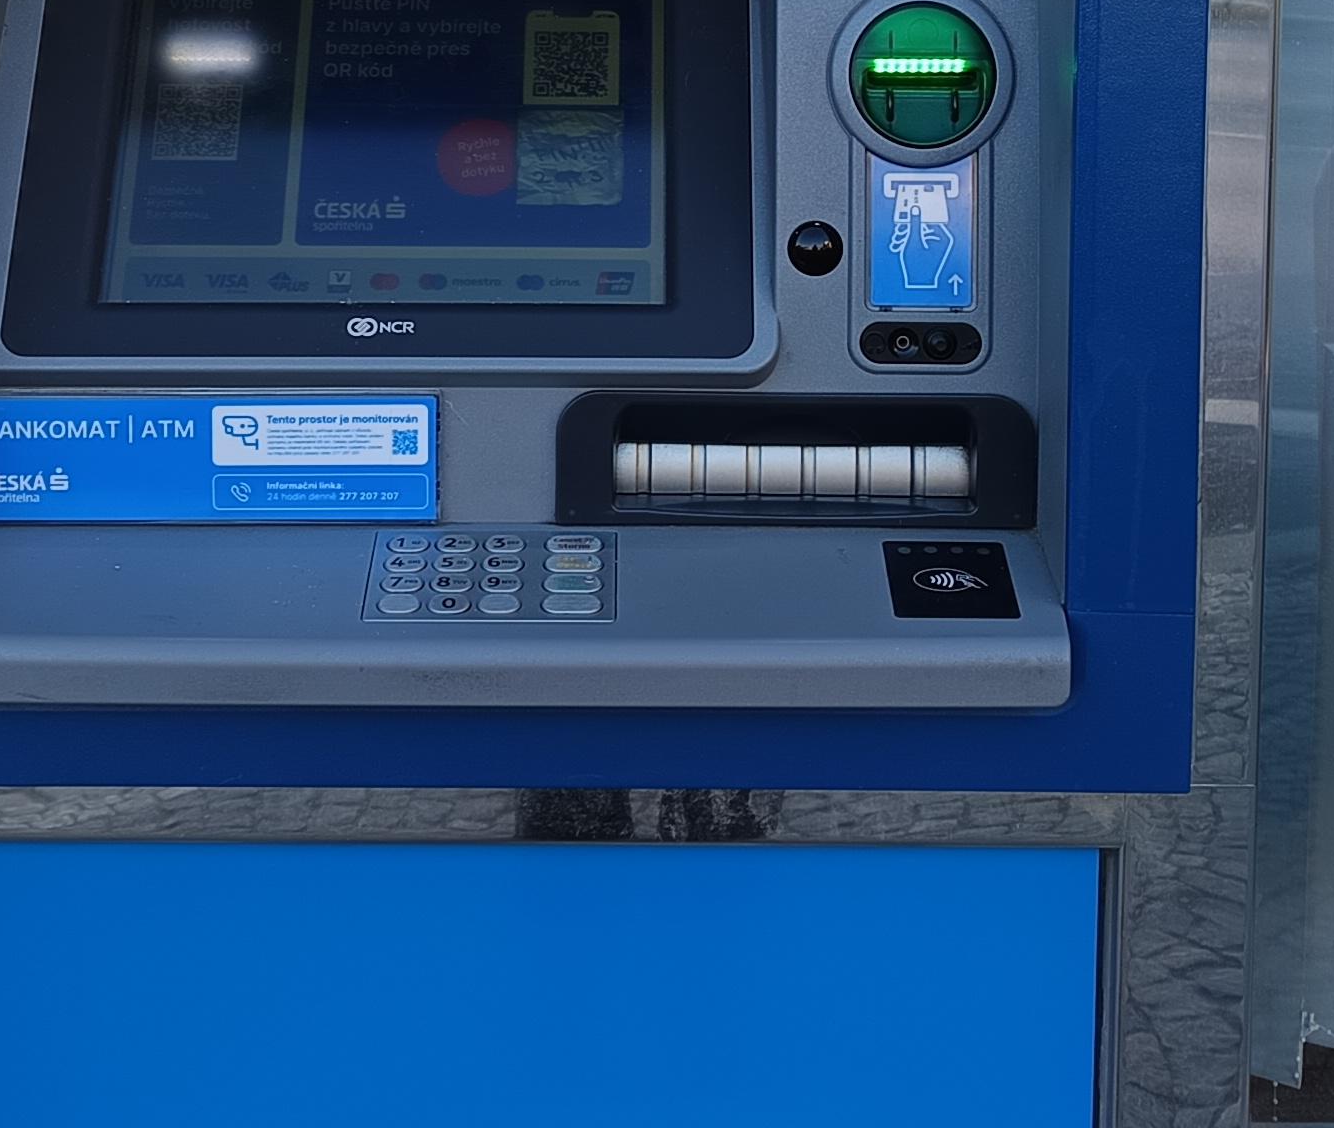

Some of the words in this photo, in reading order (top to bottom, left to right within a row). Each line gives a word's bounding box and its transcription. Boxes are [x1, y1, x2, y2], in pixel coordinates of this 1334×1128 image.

[326, 22, 335, 33] z
[343, 19, 394, 36] hlavy
[399, 22, 410, 33] a
[417, 19, 502, 37] vybírejte
[325, 40, 423, 58] bezpečně
[427, 40, 471, 60] přes
[323, 62, 353, 78] QR
[358, 61, 394, 78] kód
[313, 198, 381, 219] ČESKÁ
[312, 220, 374, 232] spořitelna
[139, 272, 185, 289] VISA
[204, 272, 249, 289] VISA
[379, 320, 415, 334] NCR
[267, 415, 296, 425] Tento
[299, 415, 337, 426] prostor
[339, 414, 350, 426] je
[352, 413, 419, 424] monitorován
[141, 419, 194, 439] ATM
[267, 481, 317, 490] Informační
[267, 492, 278, 501] 24
[281, 491, 307, 501] hodin
[339, 492, 358, 501] 277
[359, 492, 378, 501] 207
[380, 492, 400, 501] 207
[396, 538, 405, 547] 1
[444, 537, 457, 548] 2
[493, 537, 506, 548] 3
[390, 557, 405, 567] 4
[441, 557, 454, 567] 5
[487, 557, 501, 567] 6
[390, 576, 404, 587] 7
[436, 576, 451, 587] 8
[487, 576, 501, 587] 9
[442, 597, 456, 608] 0
